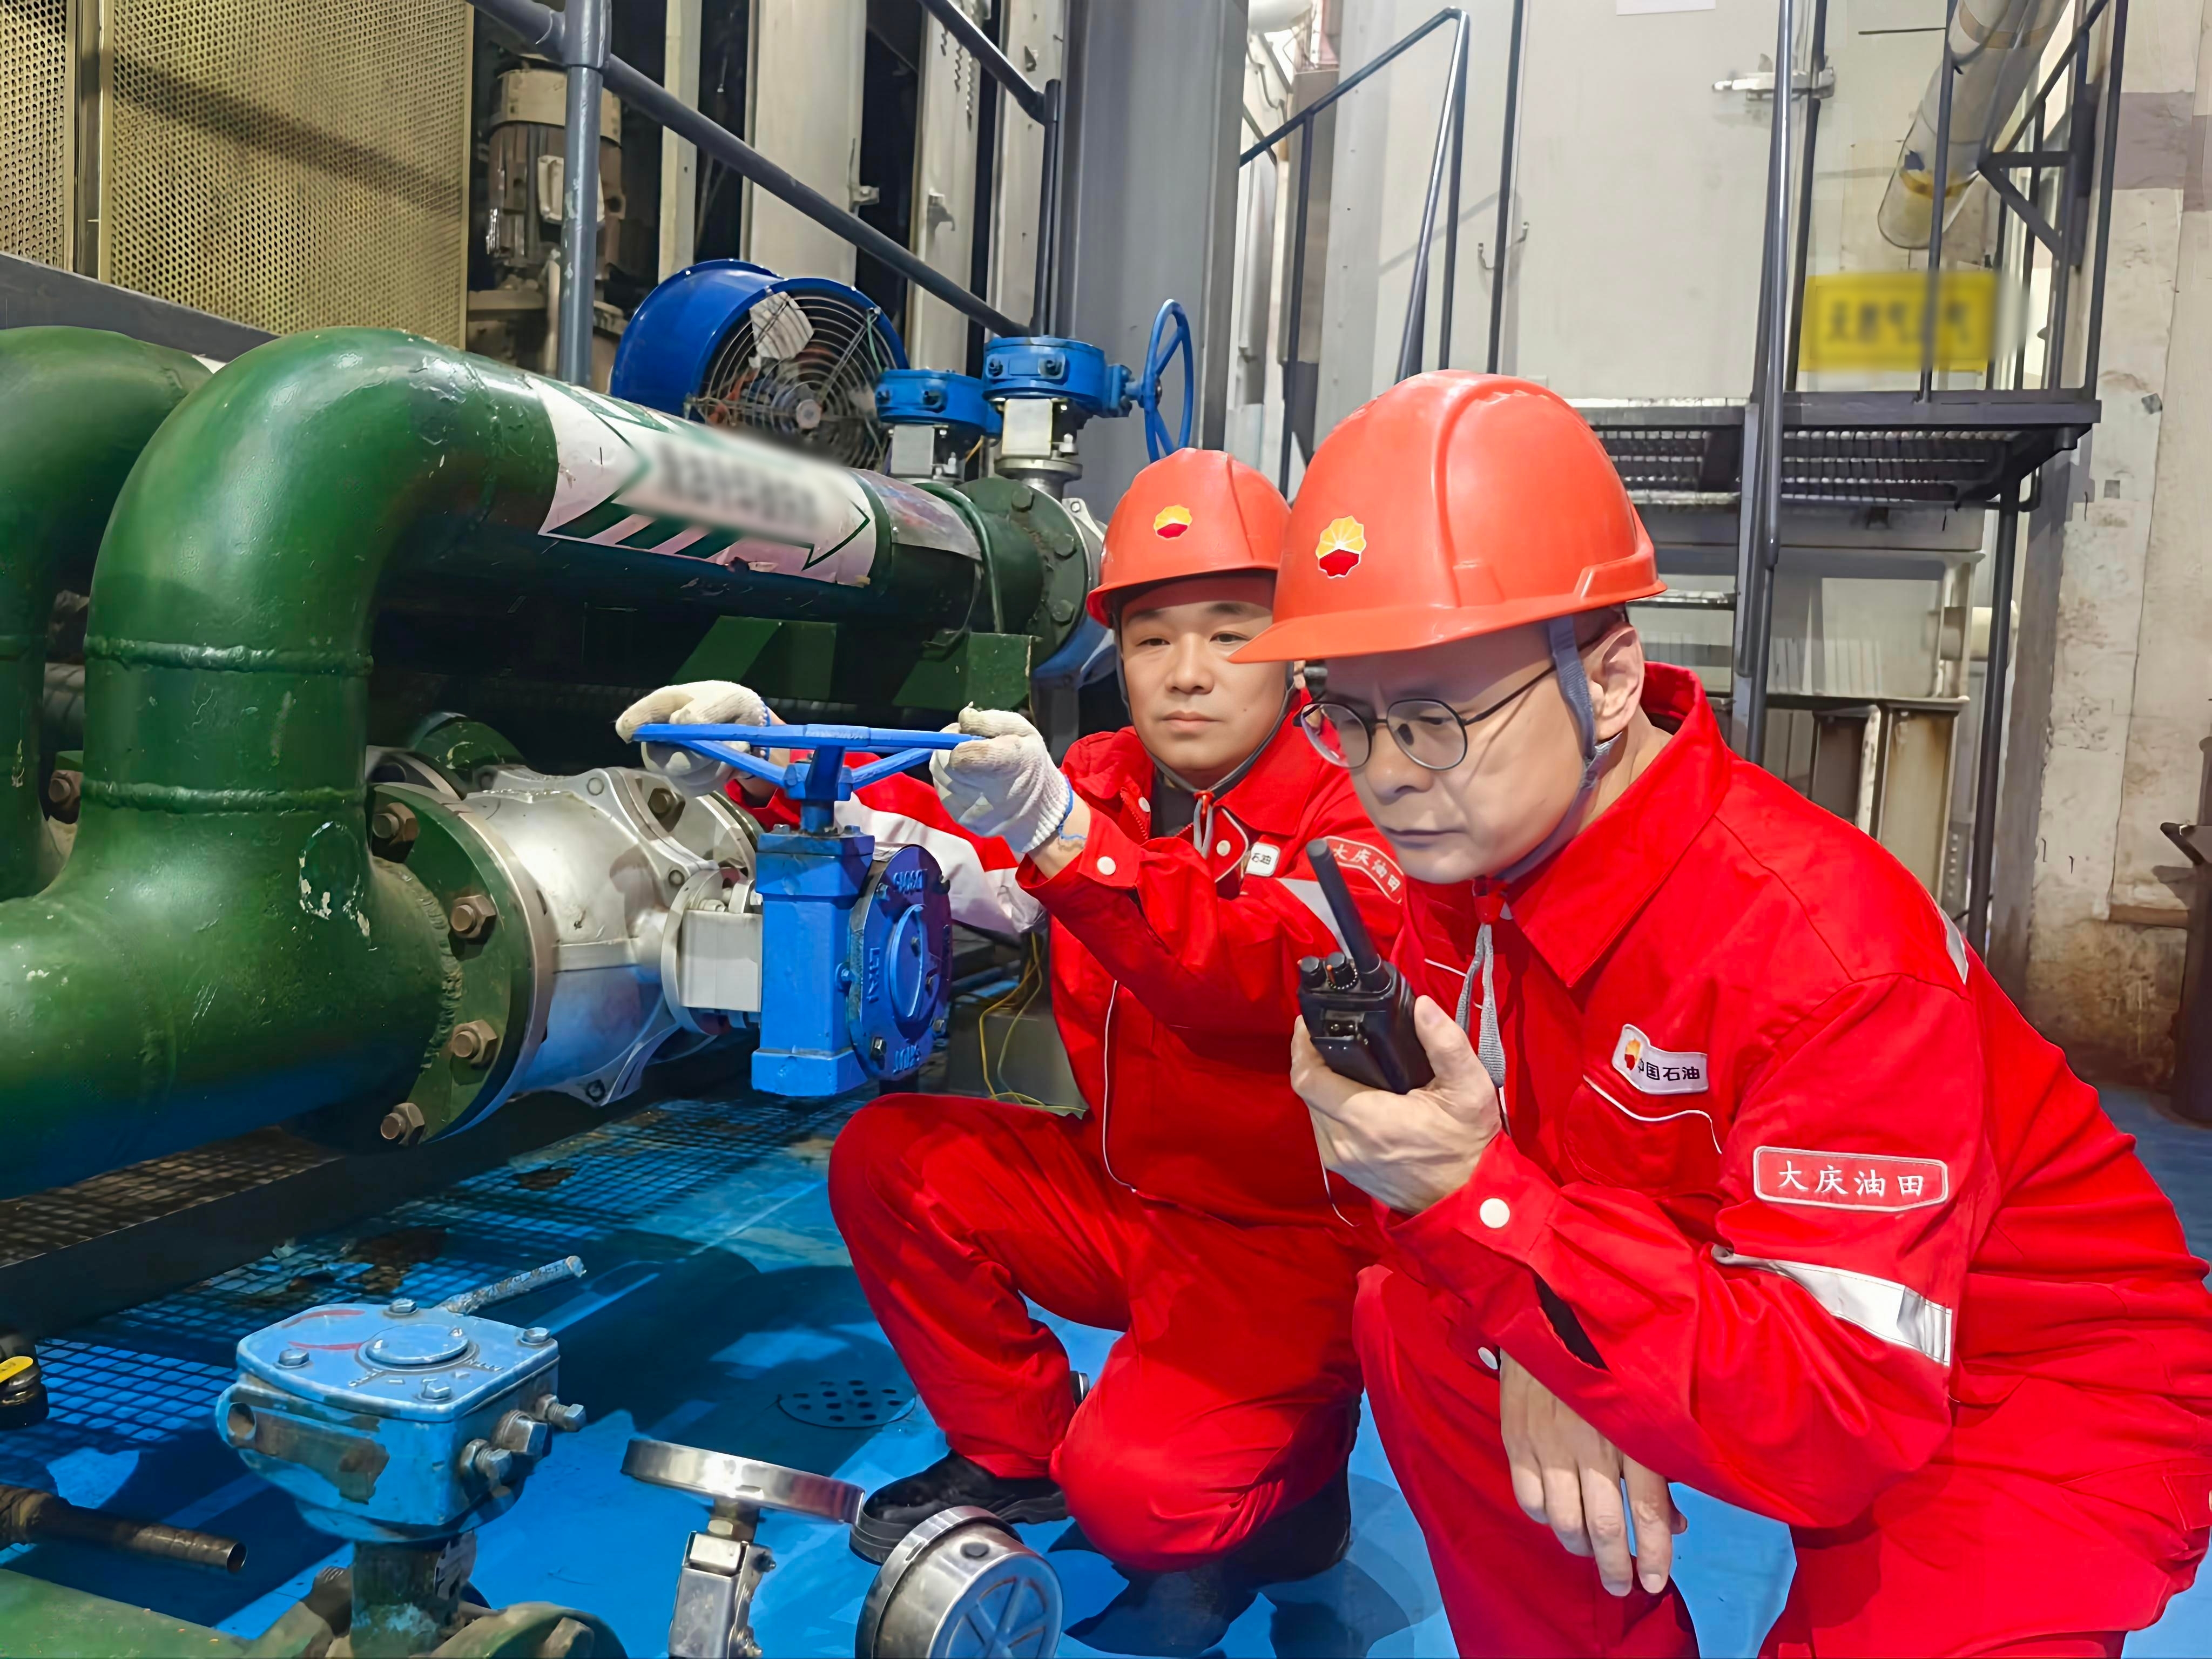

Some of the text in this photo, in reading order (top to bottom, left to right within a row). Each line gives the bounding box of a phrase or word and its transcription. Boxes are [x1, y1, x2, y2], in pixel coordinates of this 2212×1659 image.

[1333, 844, 1401, 892] 大庆油田
[1777, 1160, 1924, 1197] 大庆油田
